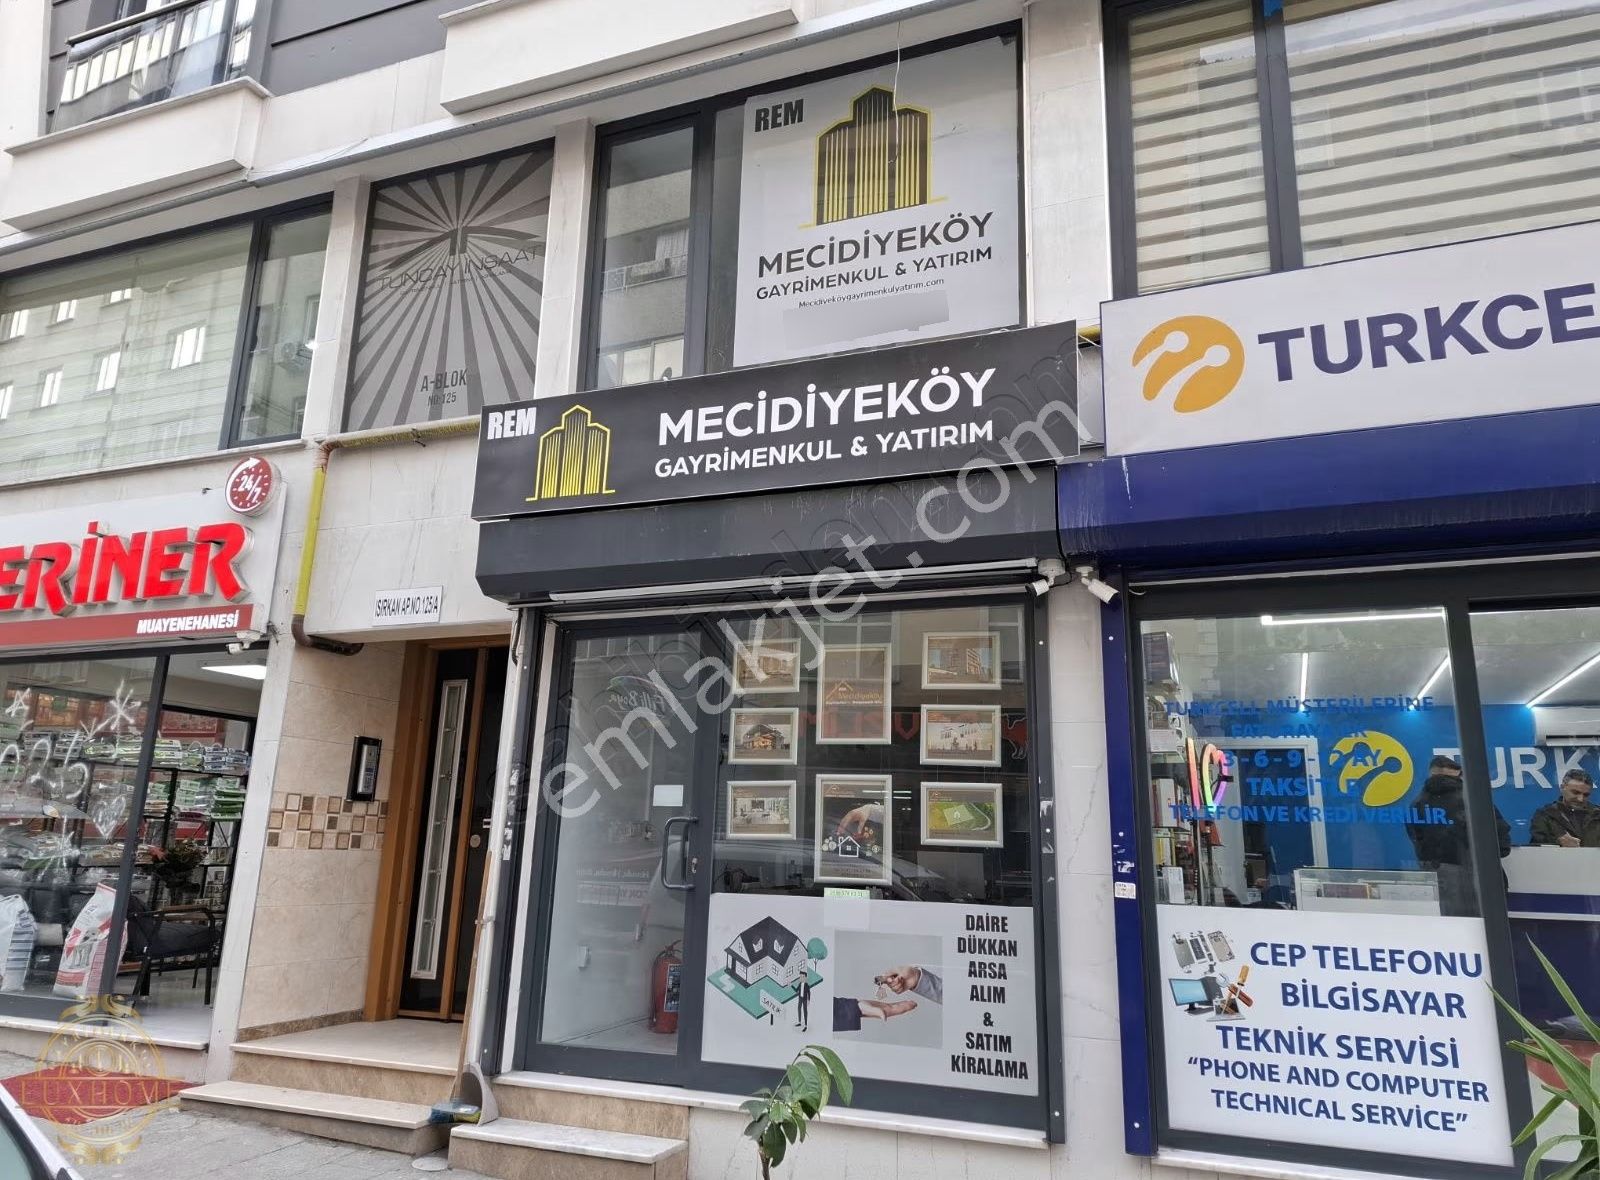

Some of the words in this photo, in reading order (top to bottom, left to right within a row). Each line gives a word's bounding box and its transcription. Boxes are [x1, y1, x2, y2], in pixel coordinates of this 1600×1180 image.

[754, 99, 804, 133] REM
[758, 211, 994, 278] MECİDİYEKÖY
[756, 266, 888, 300] GAYRİMENKUL
[895, 262, 907, 276] &
[912, 247, 992, 273] YATIRIM
[420, 368, 468, 392] A-BLOK
[658, 366, 996, 446] MECİDİYEKÖY
[486, 406, 537, 440] REM
[654, 440, 842, 478] GAYRİMENKUL
[850, 436, 868, 456] &
[875, 419, 994, 454] YATIRIM
[136, 609, 240, 634] MUAYENEHANESİ
[1259, 805, 1291, 824] VE
[965, 912, 1009, 933] DAİRE
[957, 935, 1018, 957] DÜKKAN
[1250, 941, 1307, 968] CEP
[1312, 944, 1483, 978] TELEFONU
[967, 961, 1008, 981] ARSA
[969, 984, 1006, 1004] ALIM
[1280, 978, 1467, 1019] BİLGİSAYAR
[983, 1012, 994, 1027] &
[965, 1031, 1012, 1054] SATIM
[1215, 1025, 1329, 1058] TEKNİK
[1335, 1034, 1460, 1069] SERVİSİ
[951, 1052, 1029, 1081] KİRALAMA
[1286, 1065, 1340, 1088] AND
[1345, 1070, 1490, 1103] COMPUTER
[1210, 1088, 1346, 1121] TECHNICAL
